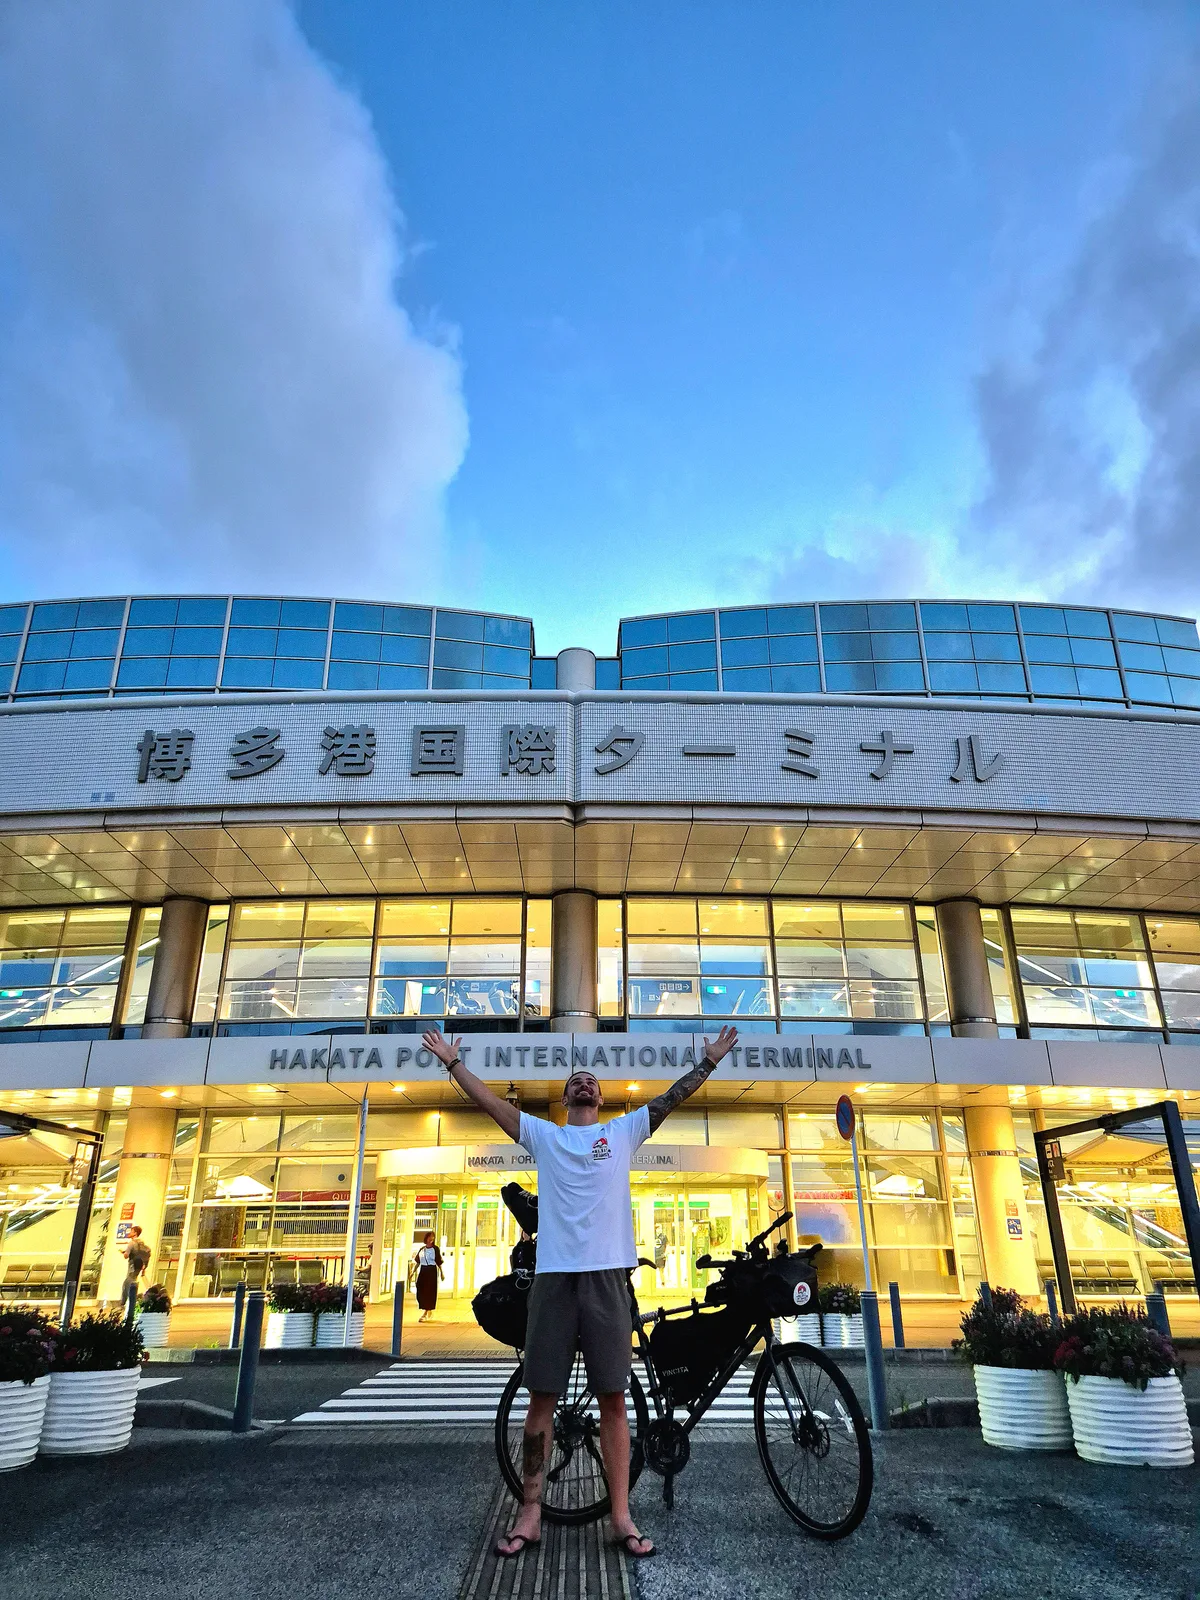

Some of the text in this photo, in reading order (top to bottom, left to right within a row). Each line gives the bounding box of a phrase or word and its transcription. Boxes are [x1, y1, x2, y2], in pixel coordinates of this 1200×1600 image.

[137, 723, 1004, 783] 博多港国際ターミナル
[270, 1046, 872, 1070] HAKATA POT INTERNATIONA TERMINAL
[468, 1156, 504, 1167] HAKATA
